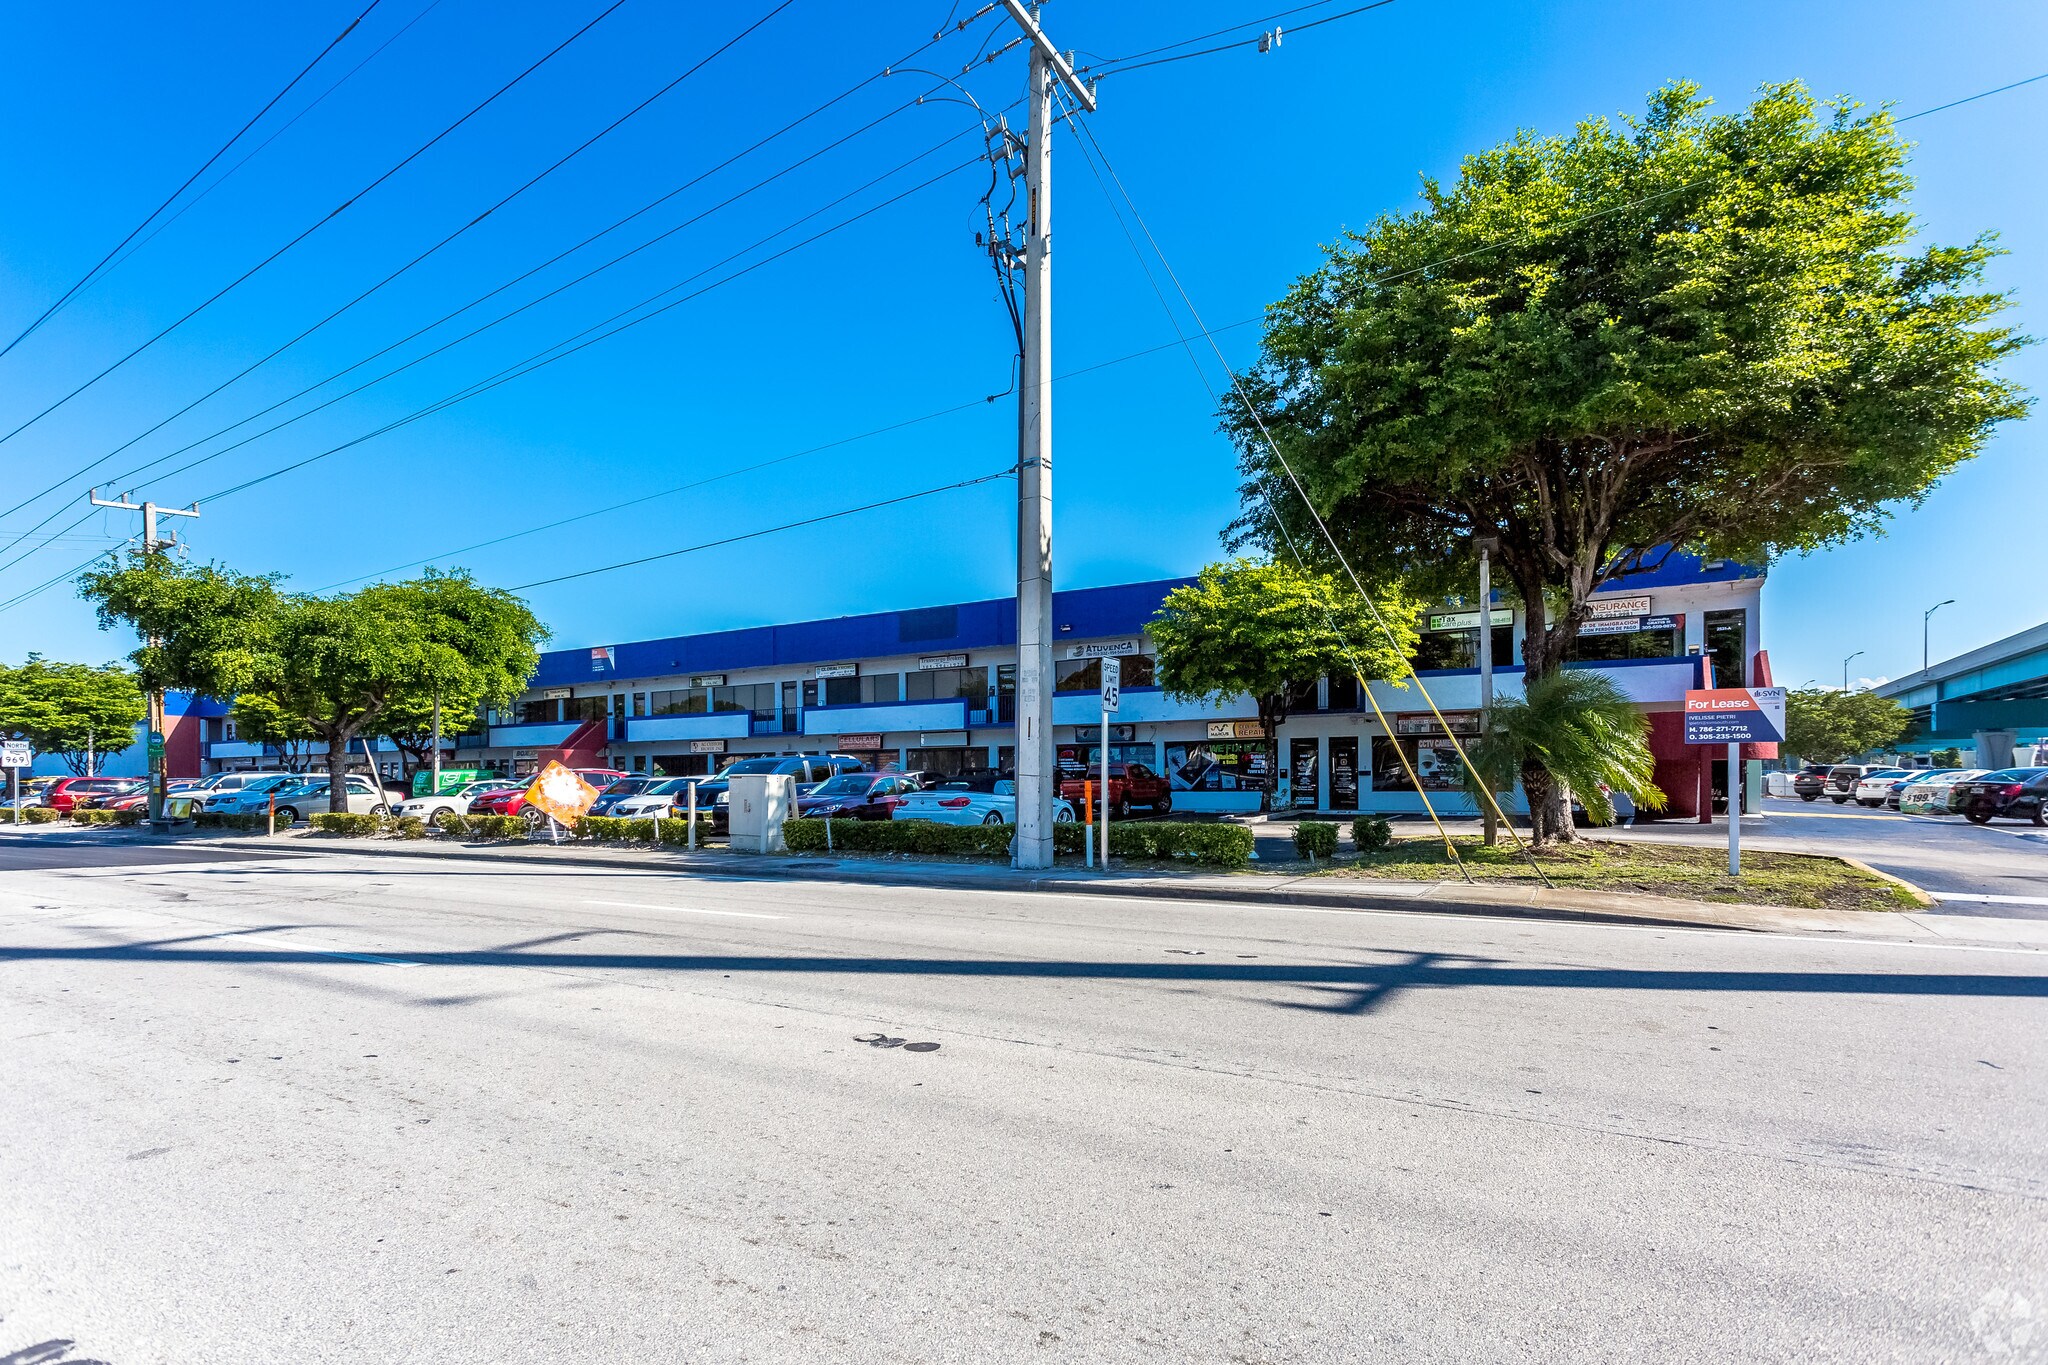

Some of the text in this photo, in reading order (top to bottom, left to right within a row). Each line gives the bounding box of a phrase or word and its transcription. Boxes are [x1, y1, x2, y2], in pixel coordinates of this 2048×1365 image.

[1086, 641, 1132, 652] ATUVENCA
[1104, 663, 1118, 674] SPEED
[1106, 675, 1116, 684] LIMIT
[1104, 686, 1117, 706] 45
[1689, 700, 1749, 709] For Lease
[1226, 744, 1241, 752] FIX
